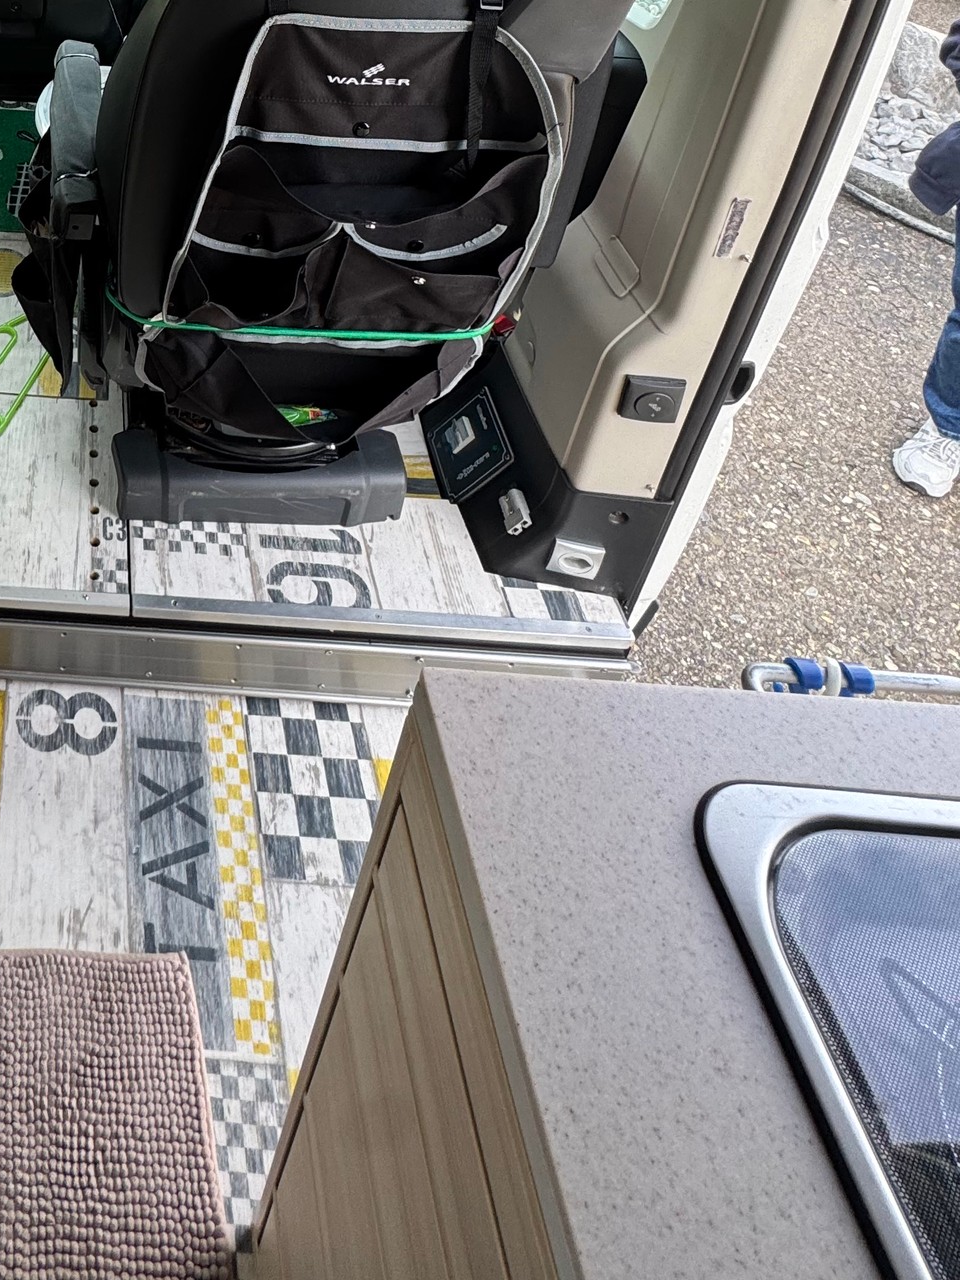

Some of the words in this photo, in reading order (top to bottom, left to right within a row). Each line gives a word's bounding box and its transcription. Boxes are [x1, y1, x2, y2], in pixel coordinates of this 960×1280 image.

[326, 75, 411, 86] WALSER
[102, 516, 127, 542] C3
[137, 736, 217, 962] TAXI
